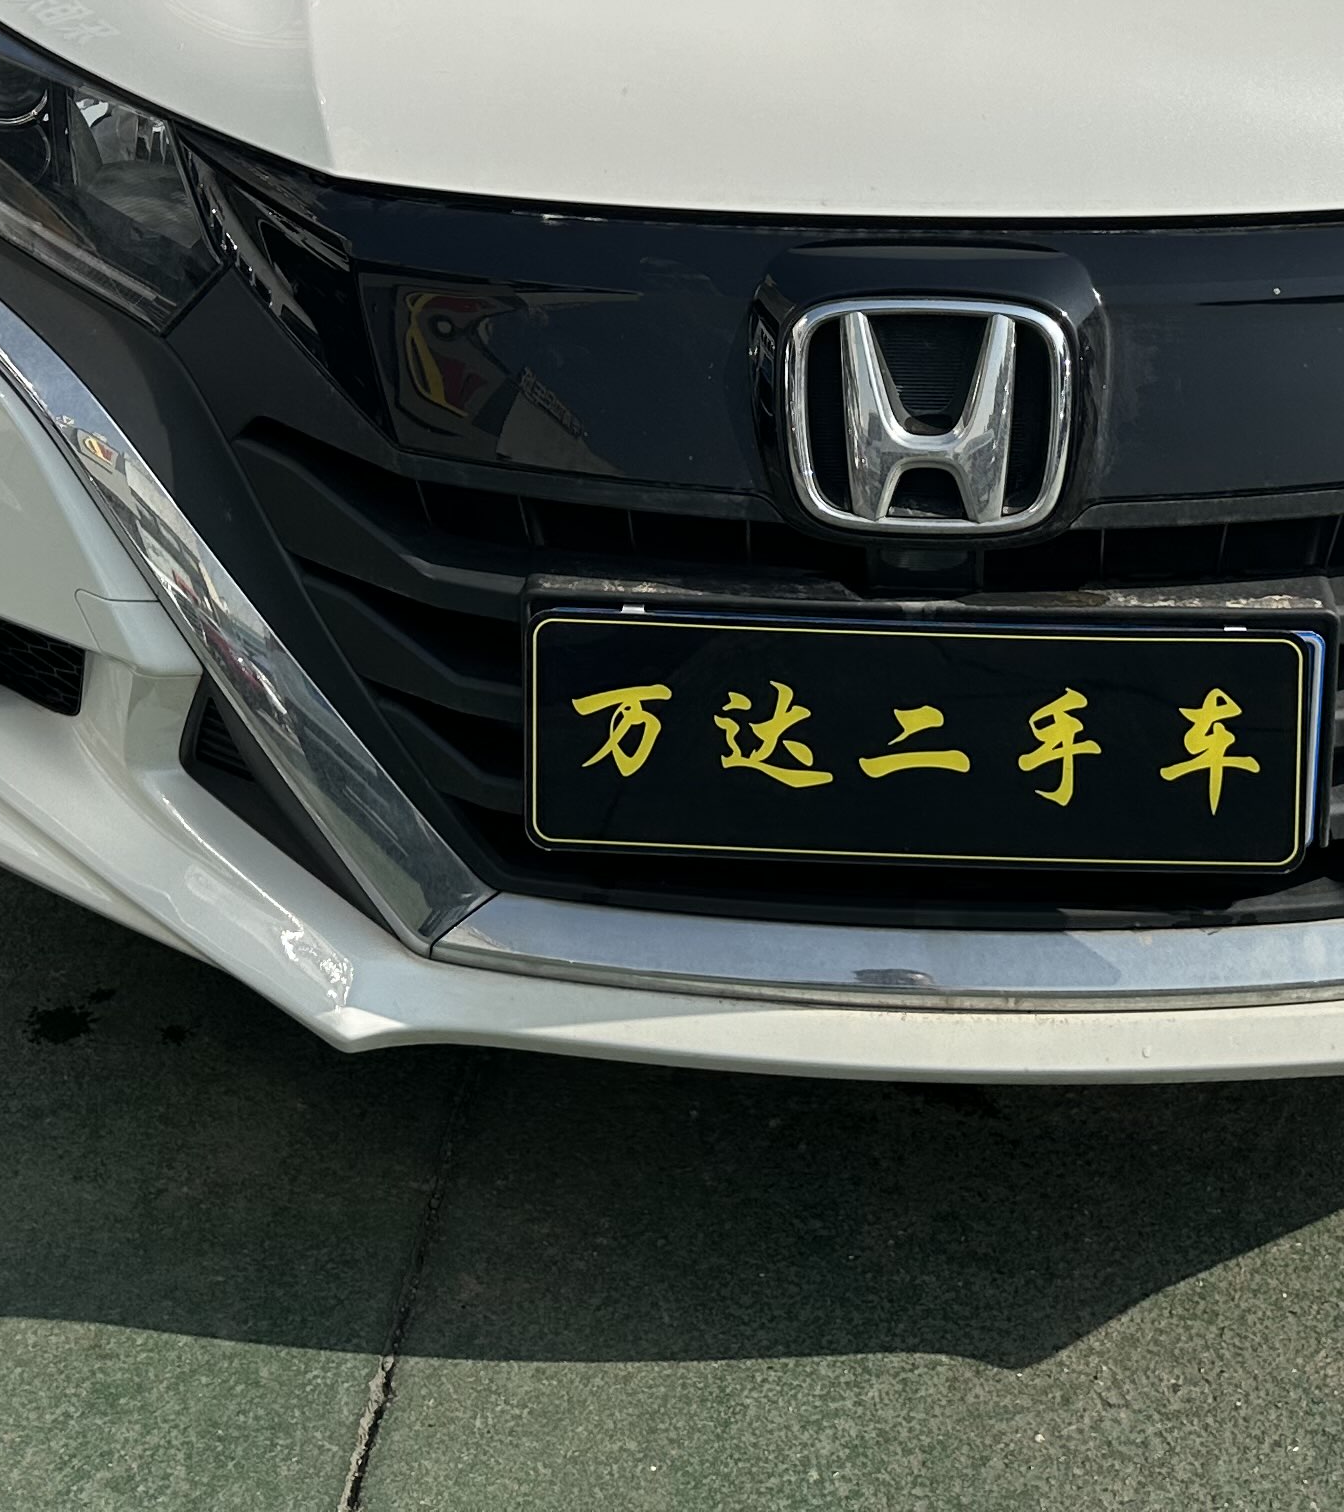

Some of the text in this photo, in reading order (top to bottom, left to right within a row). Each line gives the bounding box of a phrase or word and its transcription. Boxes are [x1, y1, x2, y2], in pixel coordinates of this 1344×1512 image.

[572, 681, 1260, 816] 万达二手车
